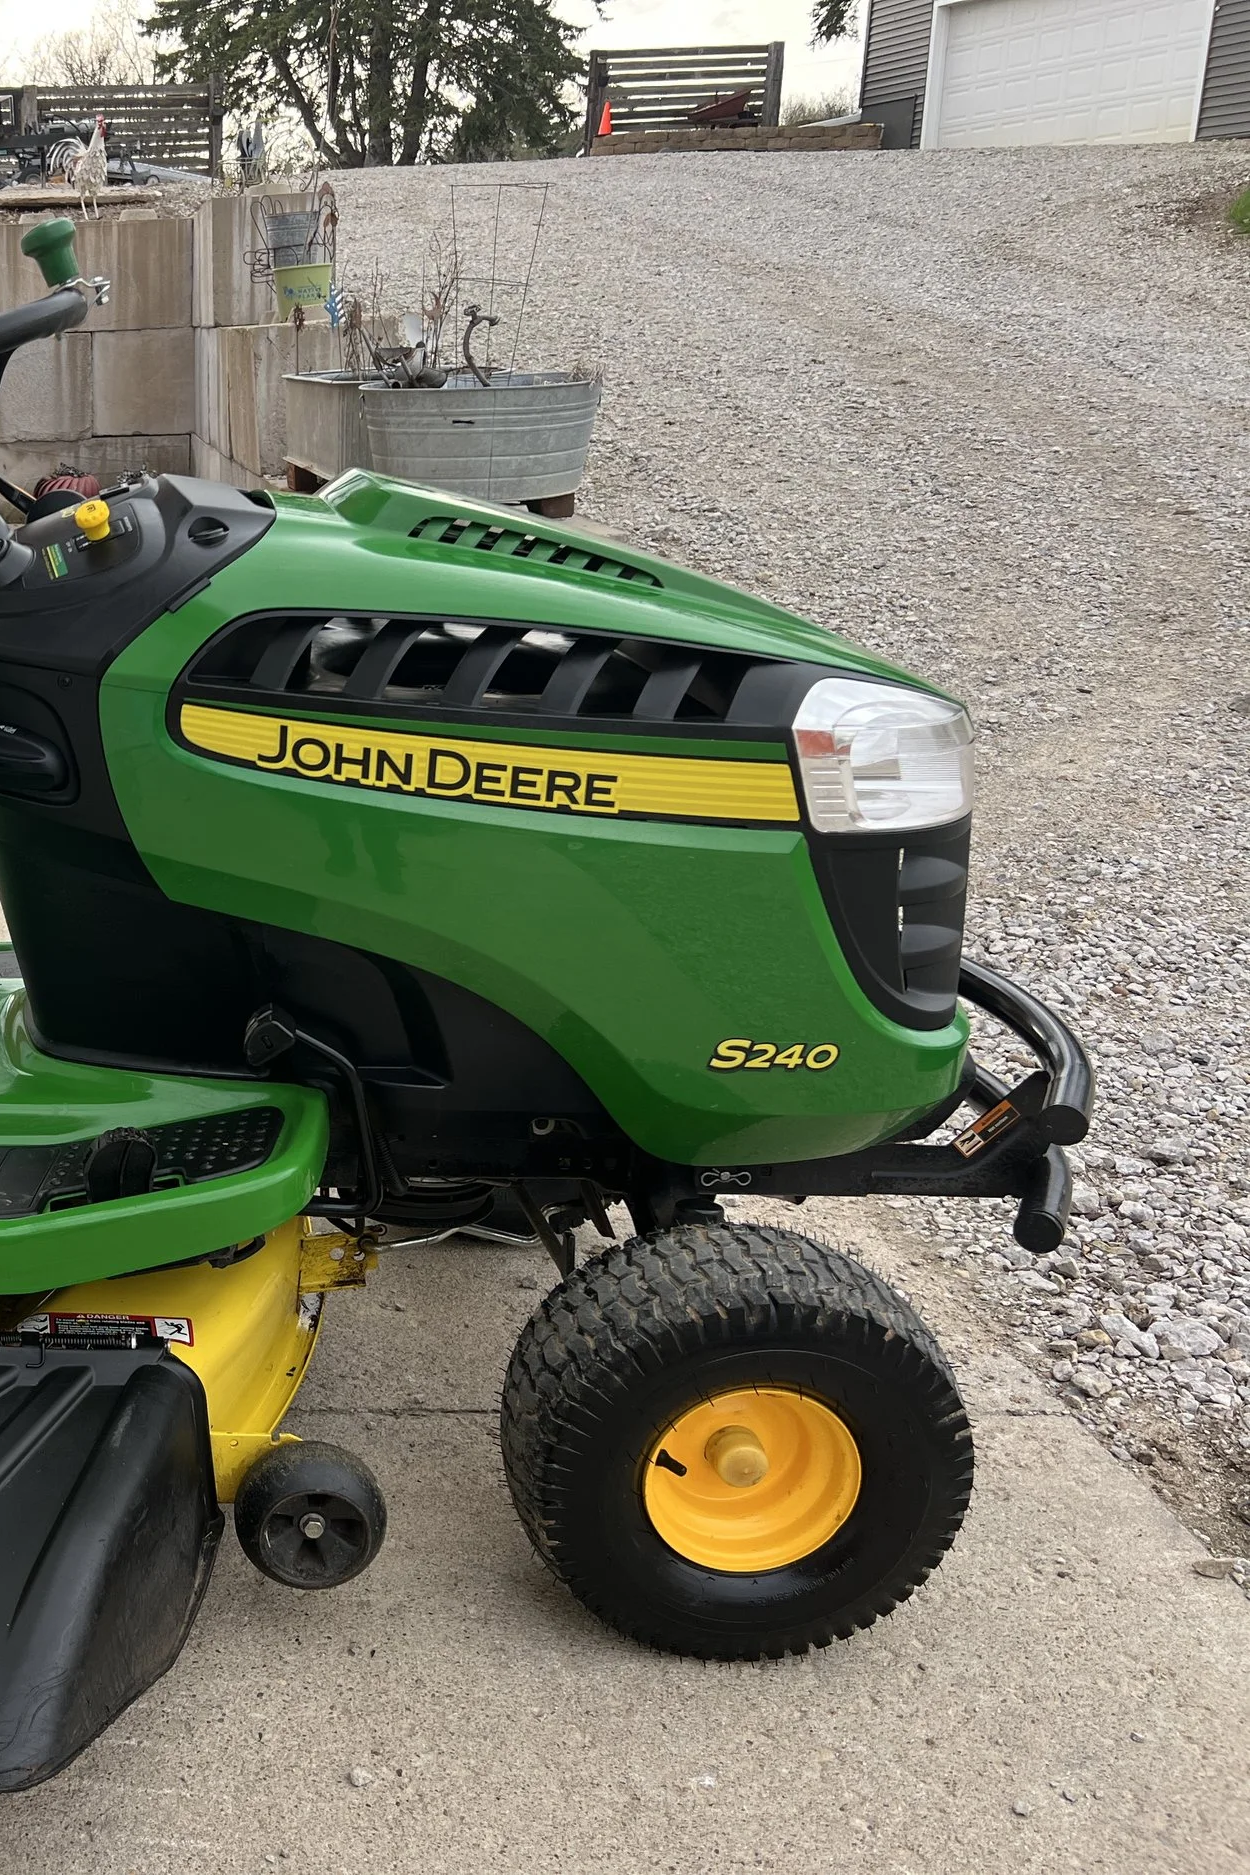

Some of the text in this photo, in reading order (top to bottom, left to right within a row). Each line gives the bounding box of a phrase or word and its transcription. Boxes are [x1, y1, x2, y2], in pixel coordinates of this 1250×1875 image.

[258, 726, 618, 808] JOHN DEERE
[709, 1038, 839, 1070] S240
